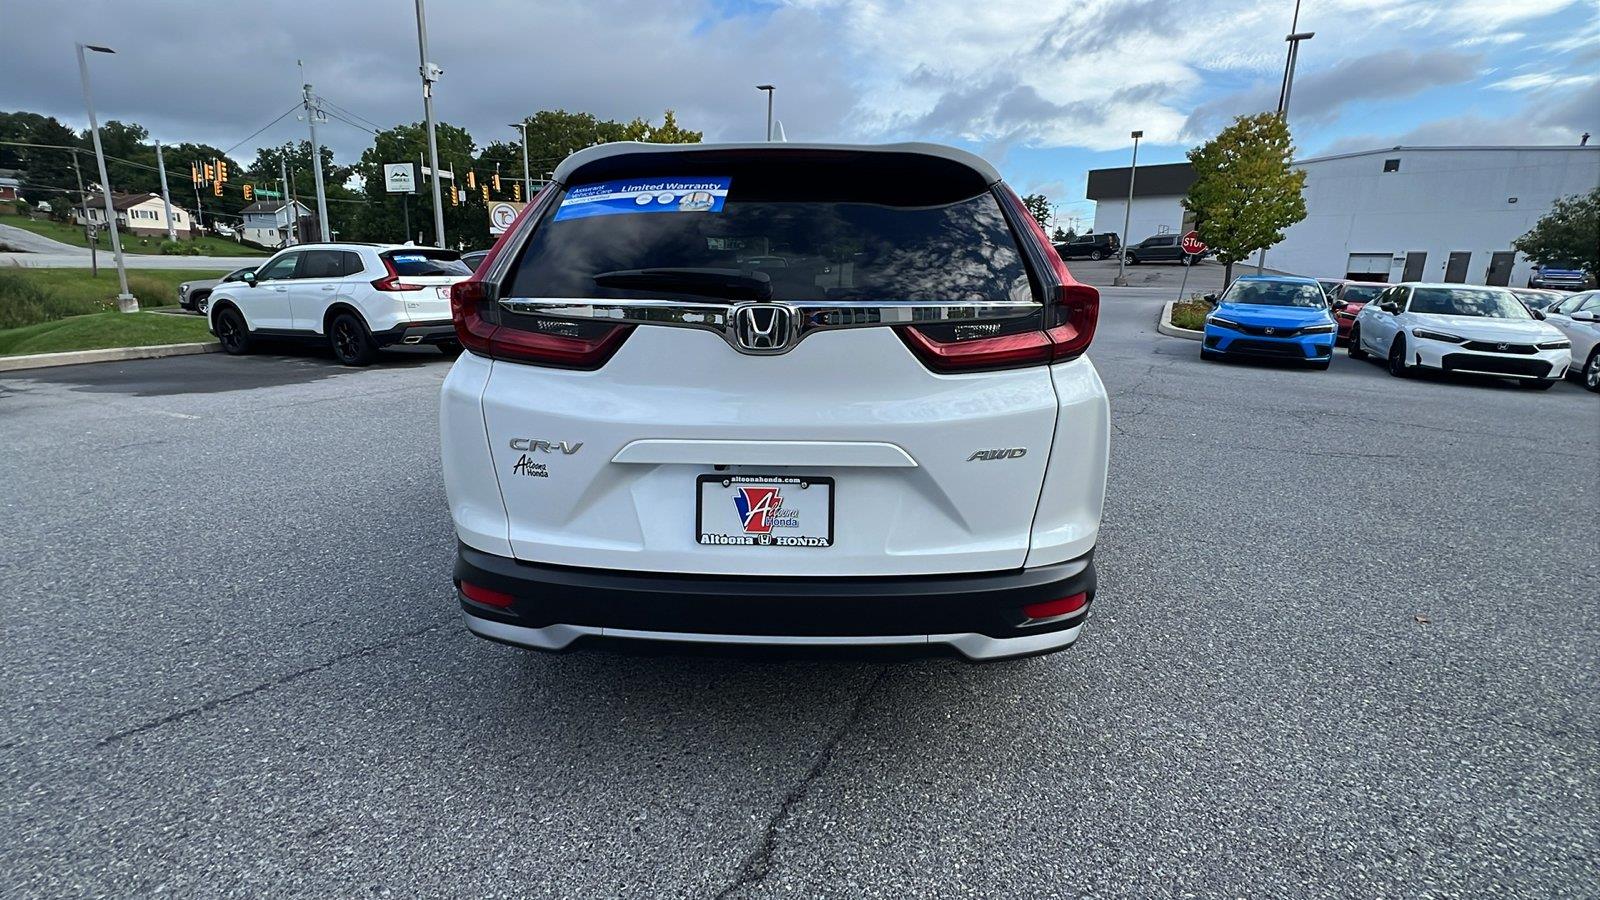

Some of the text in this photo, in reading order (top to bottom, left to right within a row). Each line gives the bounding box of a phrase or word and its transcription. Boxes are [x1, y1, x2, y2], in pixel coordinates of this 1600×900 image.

[573, 184, 605, 194] Assurant
[621, 182, 722, 193] Limited Warranty
[509, 437, 584, 455] CR-V
[966, 447, 1028, 462] AWD
[527, 468, 549, 478] Honda
[730, 476, 801, 484] altoonahonda.com
[765, 516, 799, 527] Honda
[700, 534, 829, 547] Altoona HONDA
